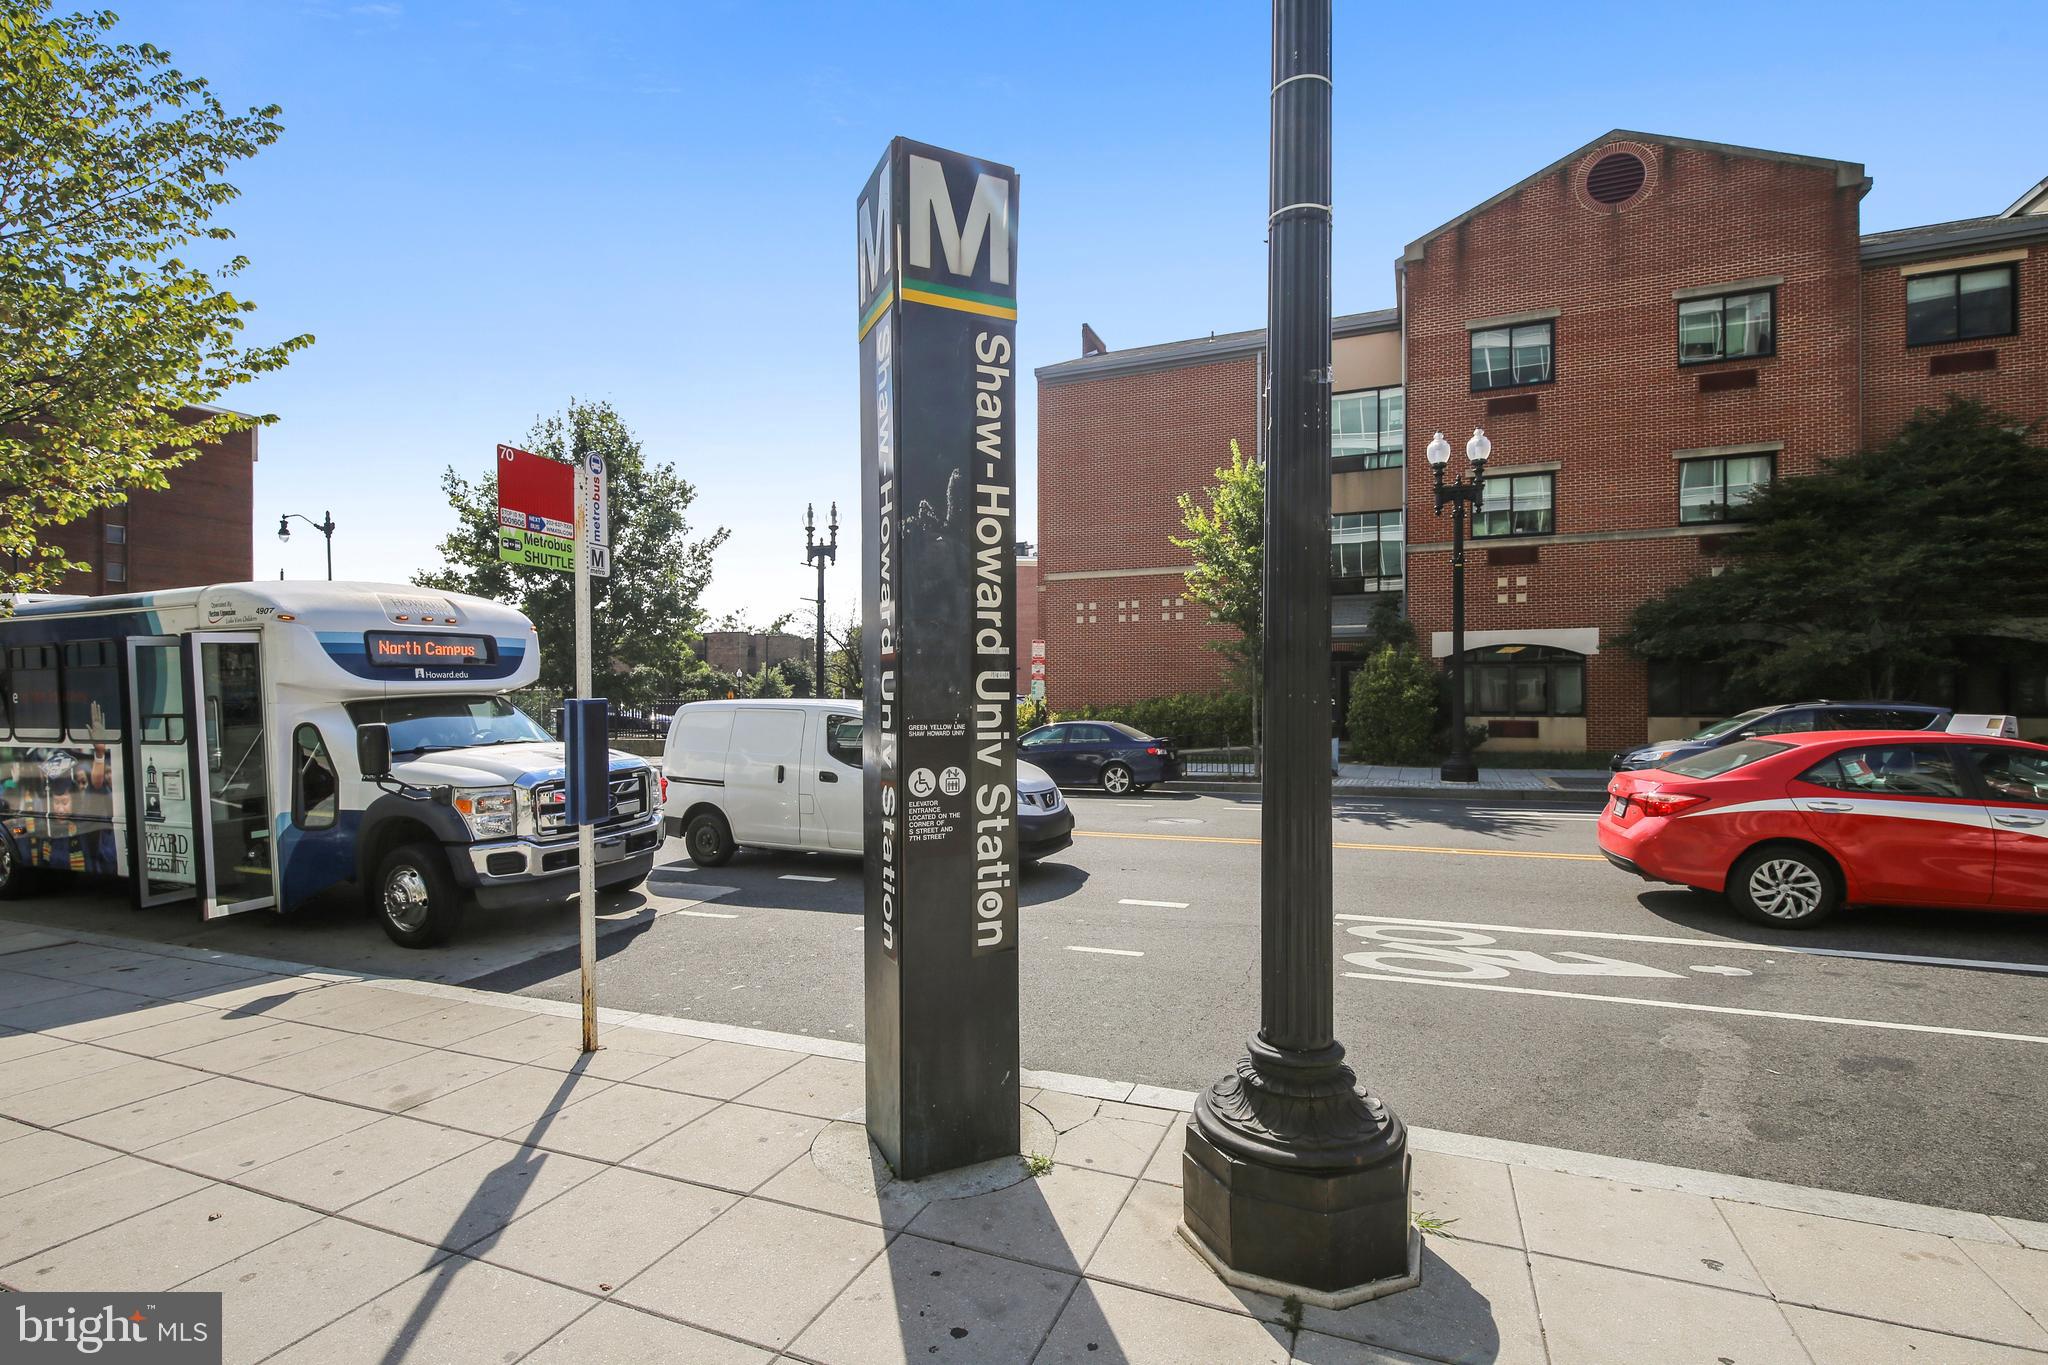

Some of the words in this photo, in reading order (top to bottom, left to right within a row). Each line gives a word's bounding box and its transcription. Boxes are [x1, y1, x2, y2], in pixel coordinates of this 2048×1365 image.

[909, 154, 1010, 286] M
[859, 159, 891, 308] M
[500, 446, 514, 461] 70
[876, 323, 893, 655] Shaw-Howard
[974, 331, 1011, 655] Shaw-Howard
[592, 476, 601, 542] metrobus
[524, 532, 573, 553] Metrobus
[524, 550, 575, 570] SHUTTLE
[591, 548, 605, 568] M
[590, 568, 606, 576] metro
[255, 607, 275, 615] 4907
[378, 640, 421, 656] North
[425, 641, 475, 657] Campus
[425, 670, 469, 679] Howard.edu
[881, 670, 896, 770] Univ
[975, 670, 1010, 768] Univ
[908, 800, 939, 808] ELEVATOR
[908, 806, 941, 815] ENTRANCE
[908, 813, 937, 822] LOCATED
[949, 811, 961, 819] THE
[908, 820, 935, 828] CORNER
[915, 826, 939, 835] STREET
[940, 825, 954, 833] AND
[922, 833, 946, 841] STREET
[144, 832, 189, 855] WARD
[147, 856, 189, 875] ERSITY
[881, 786, 896, 950] Station
[976, 783, 1011, 947] Station
